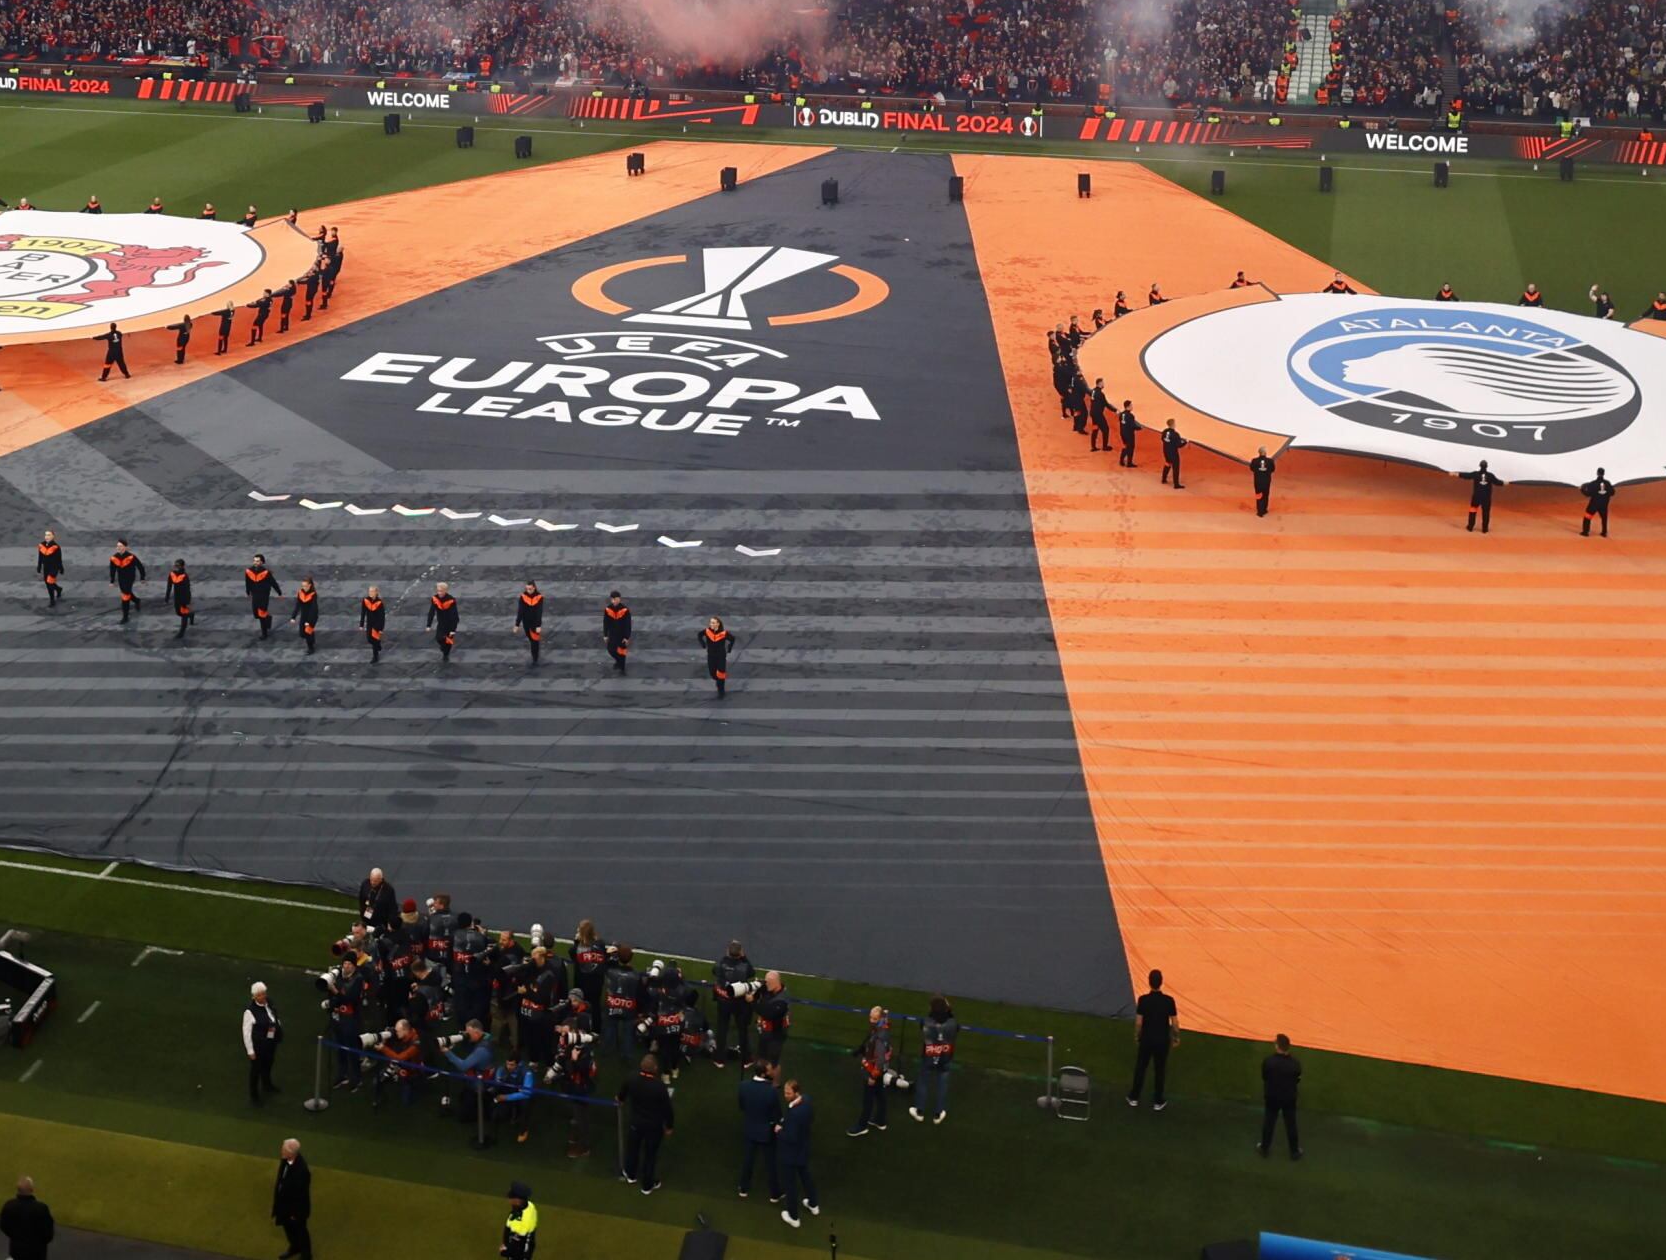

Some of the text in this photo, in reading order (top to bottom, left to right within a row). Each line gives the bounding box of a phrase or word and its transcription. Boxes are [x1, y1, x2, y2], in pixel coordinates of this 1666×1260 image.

[19, 77, 66, 92] FINAL
[69, 79, 110, 94] 2024
[367, 91, 450, 109] WELCOME
[883, 111, 950, 132] FINAL
[956, 114, 1014, 134] 2024
[1365, 133, 1469, 153] WELCOME
[28, 239, 105, 252] 1904
[1339, 317, 1568, 348] ATALANTA
[544, 336, 762, 369] UEFA
[339, 352, 882, 420] EUROPA
[415, 392, 753, 436] LEAGUE
[1389, 412, 1549, 441] 1907
